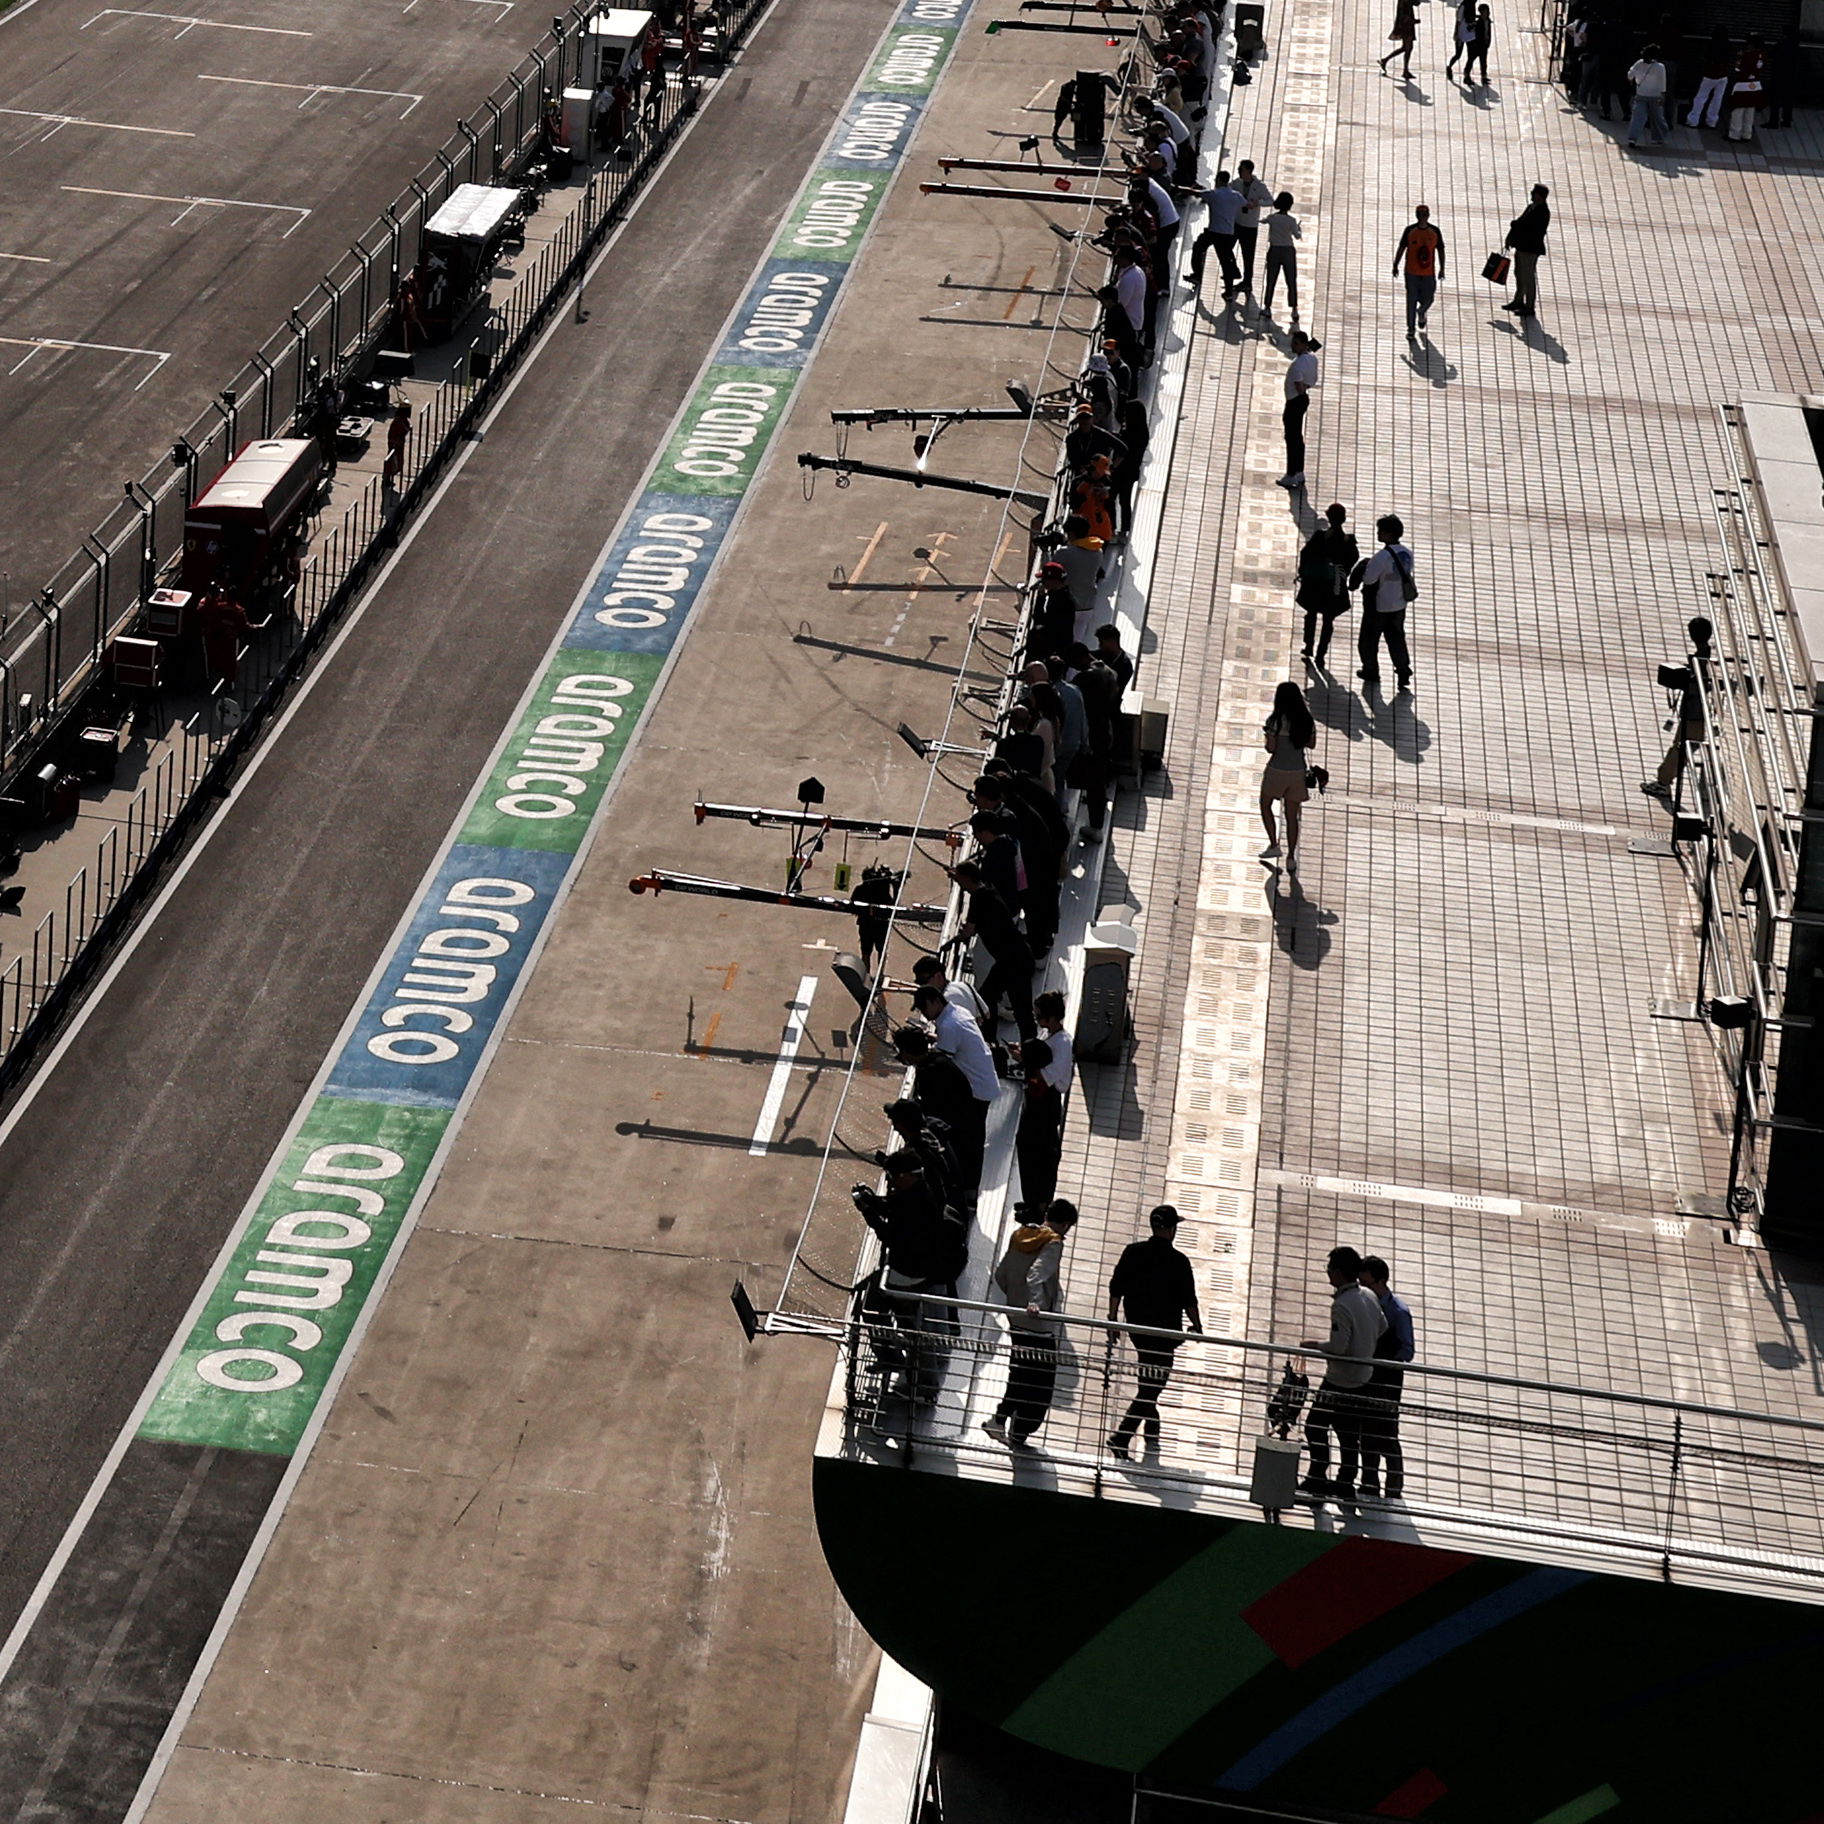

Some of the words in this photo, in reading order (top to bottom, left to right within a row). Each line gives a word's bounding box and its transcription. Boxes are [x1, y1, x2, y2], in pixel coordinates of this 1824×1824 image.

[877, 34, 944, 85] aramco
[838, 102, 911, 159] aramco
[793, 179, 874, 248] aramco
[738, 271, 829, 352] aramco
[673, 382, 776, 476] aramco
[594, 513, 712, 629] aramco
[495, 674, 634, 819] aramco
[675, 883, 687, 891] DP
[688, 885, 719, 895] WORLD
[367, 878, 535, 1064] aramco
[196, 1143, 404, 1393] aramco
